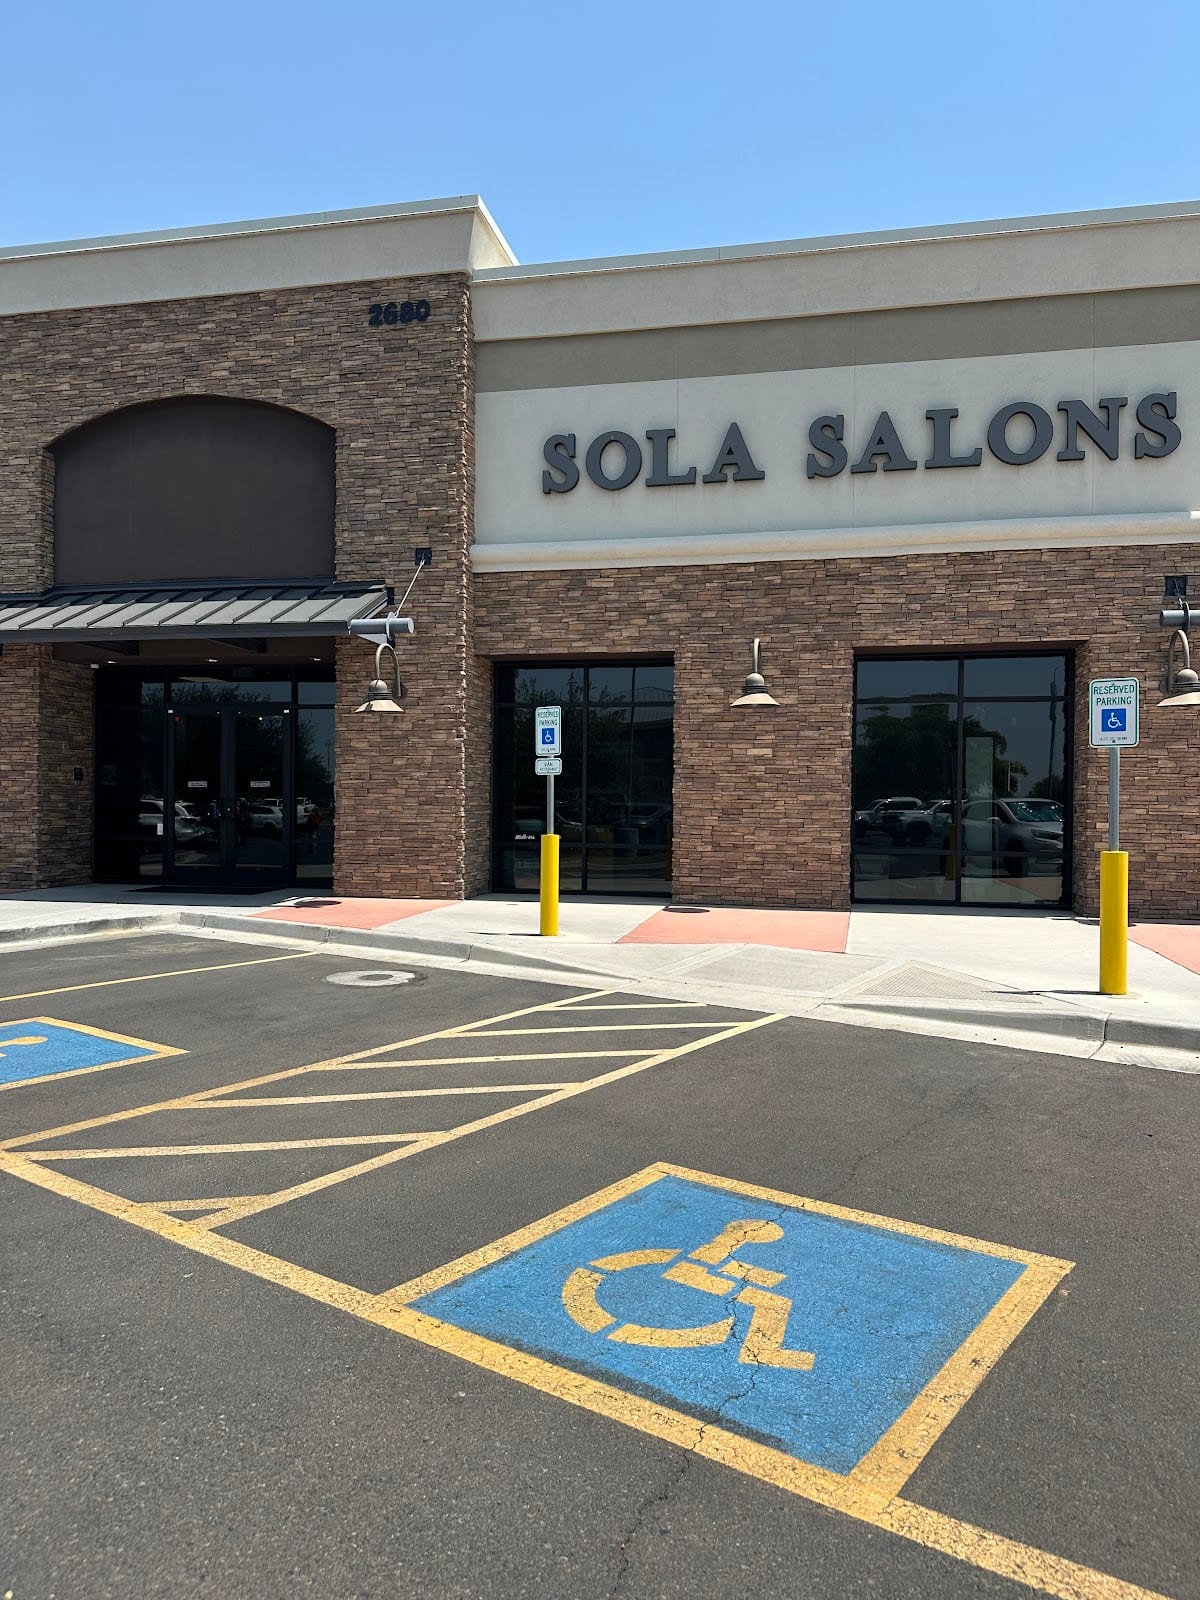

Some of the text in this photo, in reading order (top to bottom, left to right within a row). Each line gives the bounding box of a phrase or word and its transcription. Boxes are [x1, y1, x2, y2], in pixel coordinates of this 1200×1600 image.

[368, 300, 431, 326] 2680
[542, 391, 1183, 495] SOLA SALONS
[1094, 685, 1134, 695] RESERVED
[1097, 696, 1132, 706] PARKING
[538, 710, 559, 718] RESERVED
